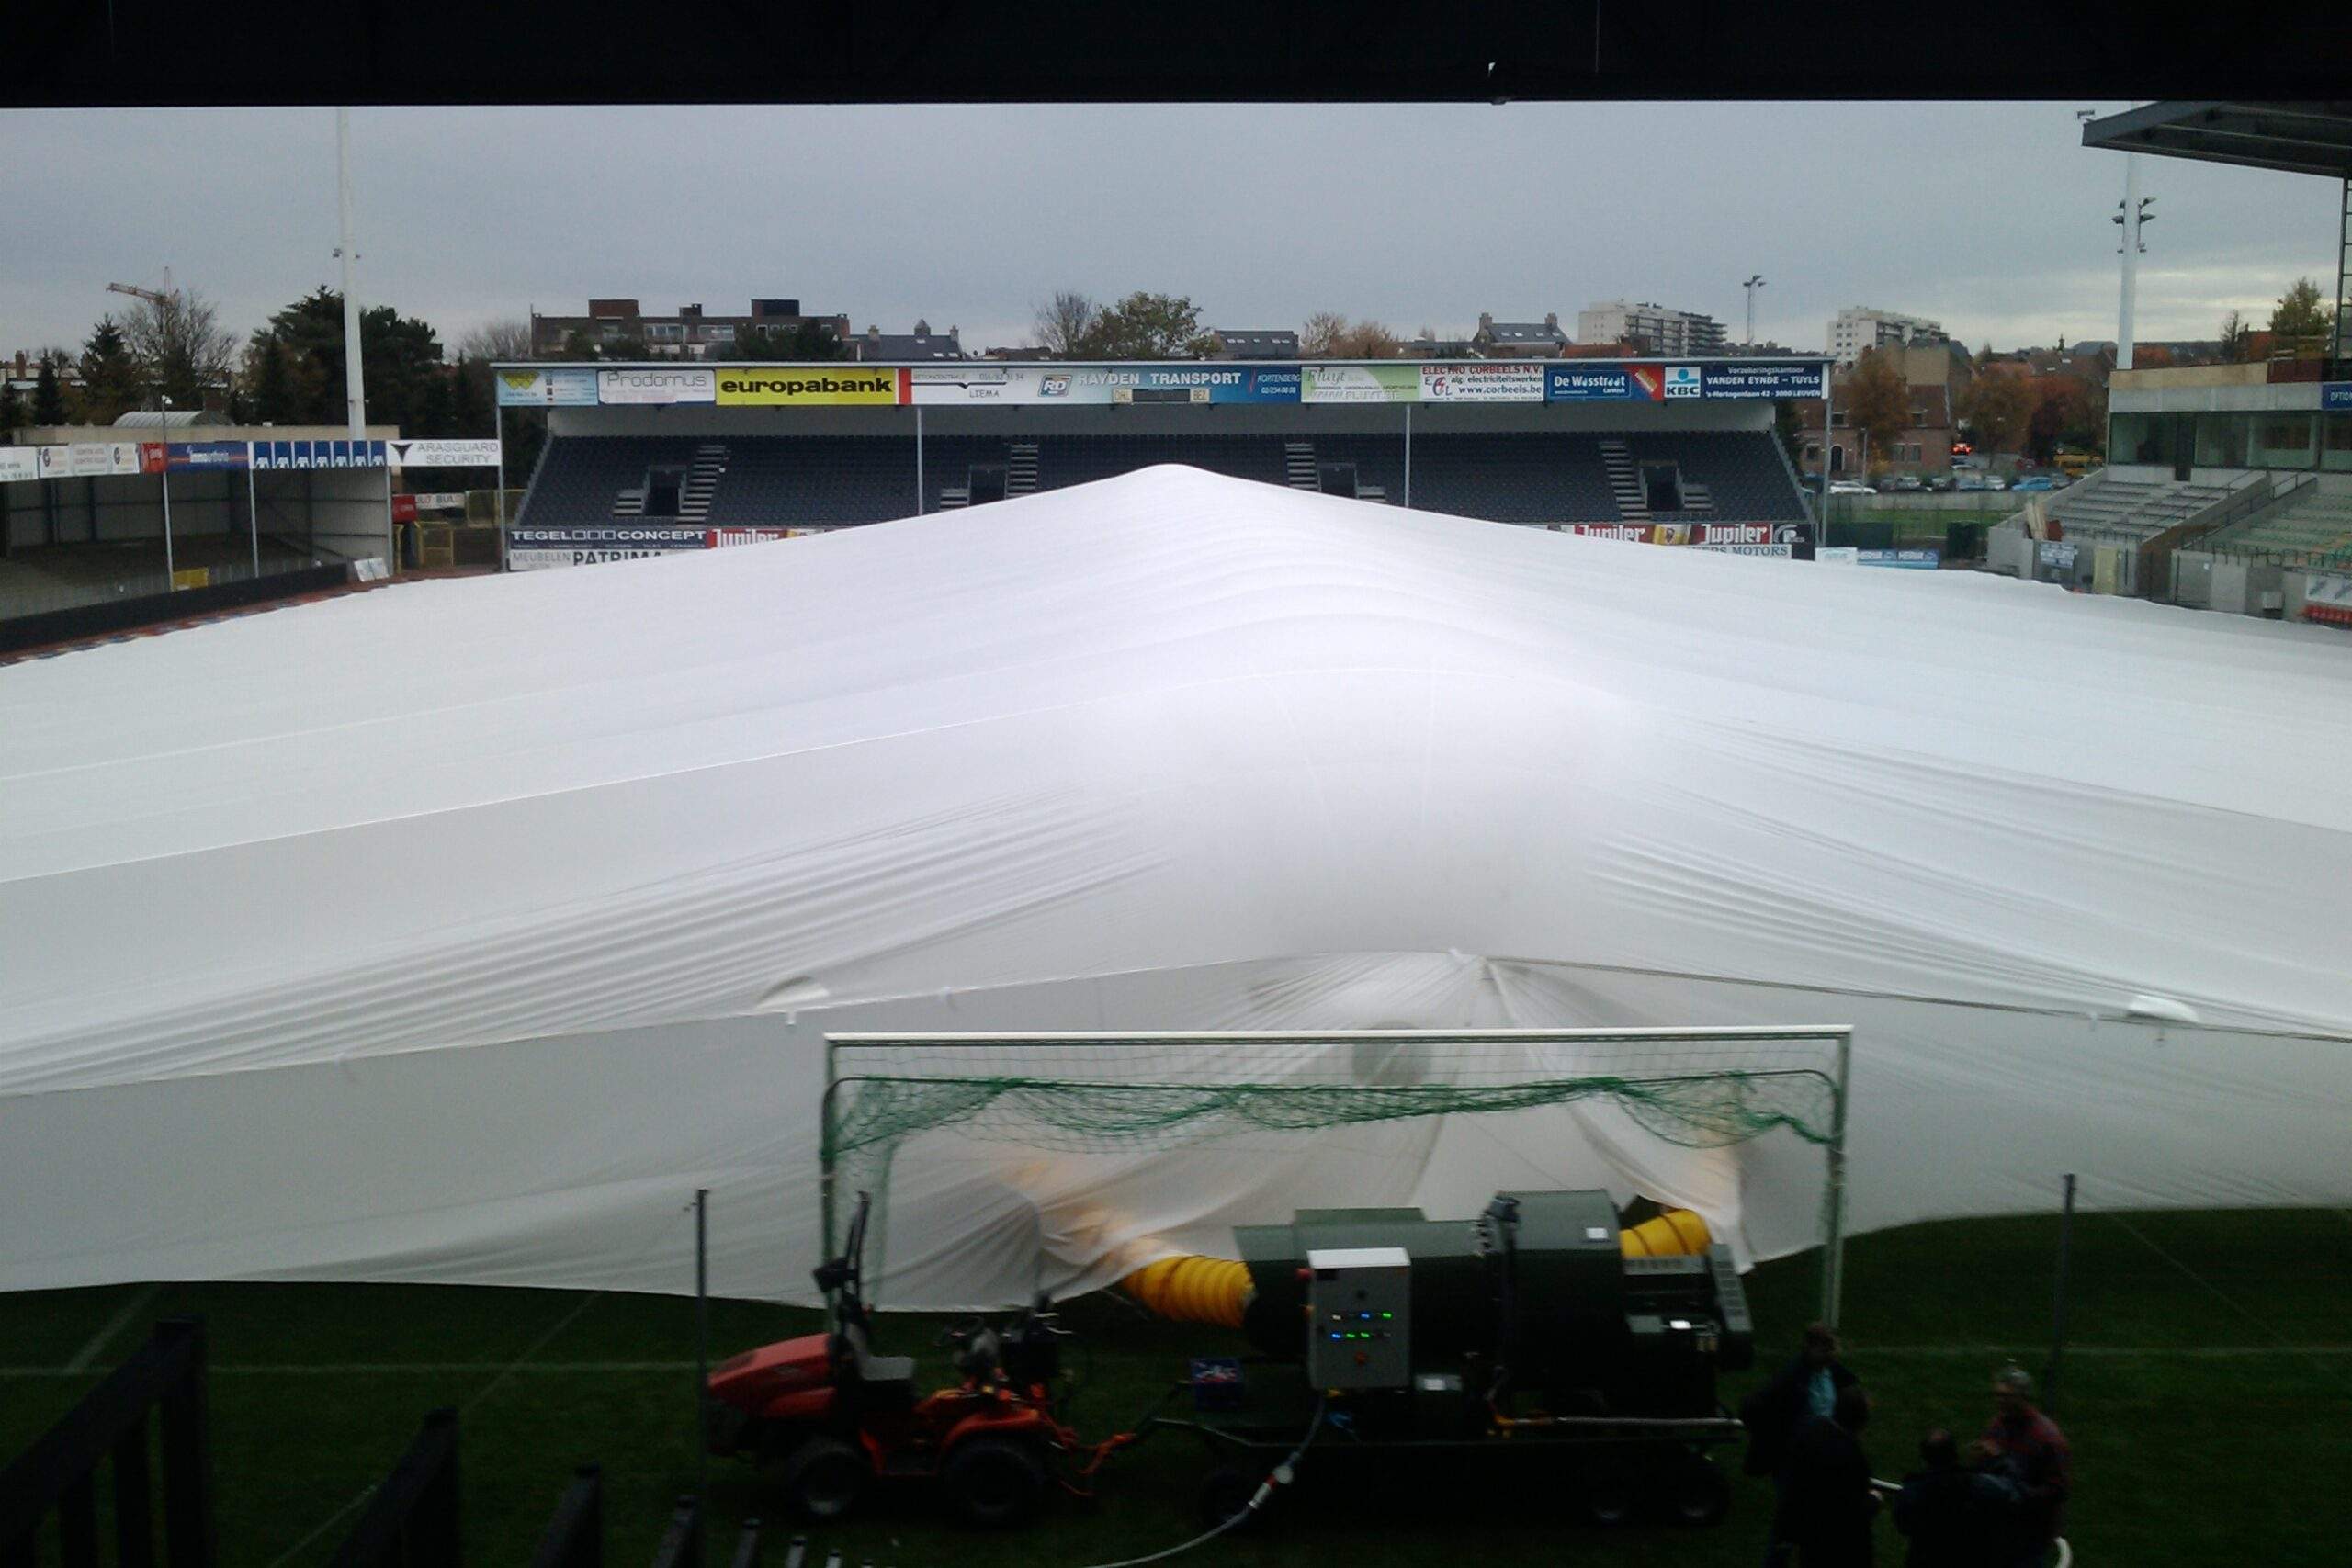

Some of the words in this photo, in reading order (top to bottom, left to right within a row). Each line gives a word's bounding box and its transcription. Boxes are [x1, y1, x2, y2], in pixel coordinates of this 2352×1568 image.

[1422, 364, 1465, 375] ELECTRO
[1470, 364, 1520, 375] CORBEELS
[1523, 364, 1543, 375] N.V.
[607, 371, 707, 388] Prodomus
[1150, 372, 1241, 385] TRANSPORT
[1555, 376, 1569, 387] De
[1572, 375, 1625, 387] Wasstraat
[1706, 377, 1745, 385] VANDEN
[1747, 376, 1779, 385] EYNDE
[1791, 376, 1819, 385] TUYLS
[721, 378, 893, 396] europabank
[1458, 385, 1542, 394] www.corbeels.be
[1666, 387, 1699, 396] KBC
[417, 443, 498, 452] ARASGUARD
[426, 454, 489, 464] SECURITY
[511, 531, 571, 540] TEGEL
[617, 531, 706, 540] CONCEPT
[1700, 523, 1768, 544] Jupiler
[512, 552, 571, 561] MEUBELEN
[1732, 547, 1788, 557] MOTORS
